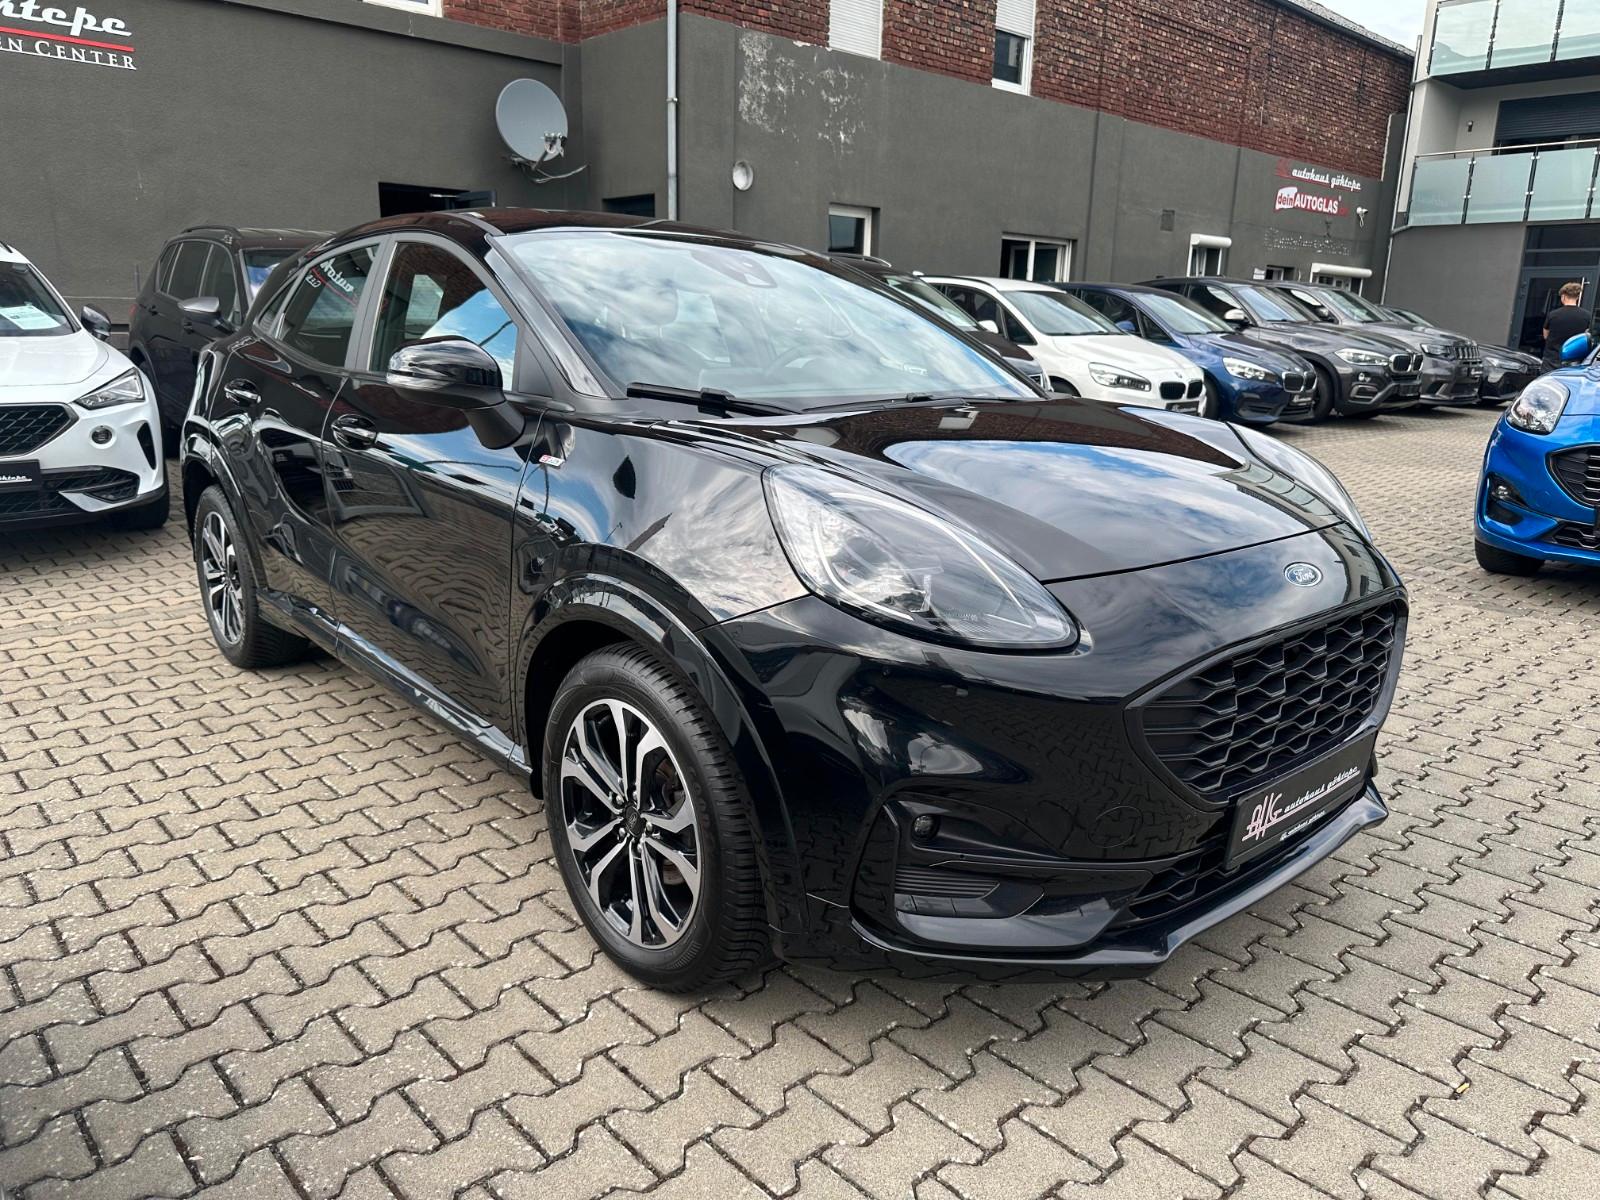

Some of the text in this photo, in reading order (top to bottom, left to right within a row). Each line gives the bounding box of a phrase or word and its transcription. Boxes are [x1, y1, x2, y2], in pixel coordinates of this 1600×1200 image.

[0, 36, 136, 69] N CENTER
[1291, 167, 1330, 184] autohaus
[1276, 193, 1294, 208] dein
[1294, 194, 1338, 214] AUTOGLAS
[1292, 568, 1315, 582] Ford
